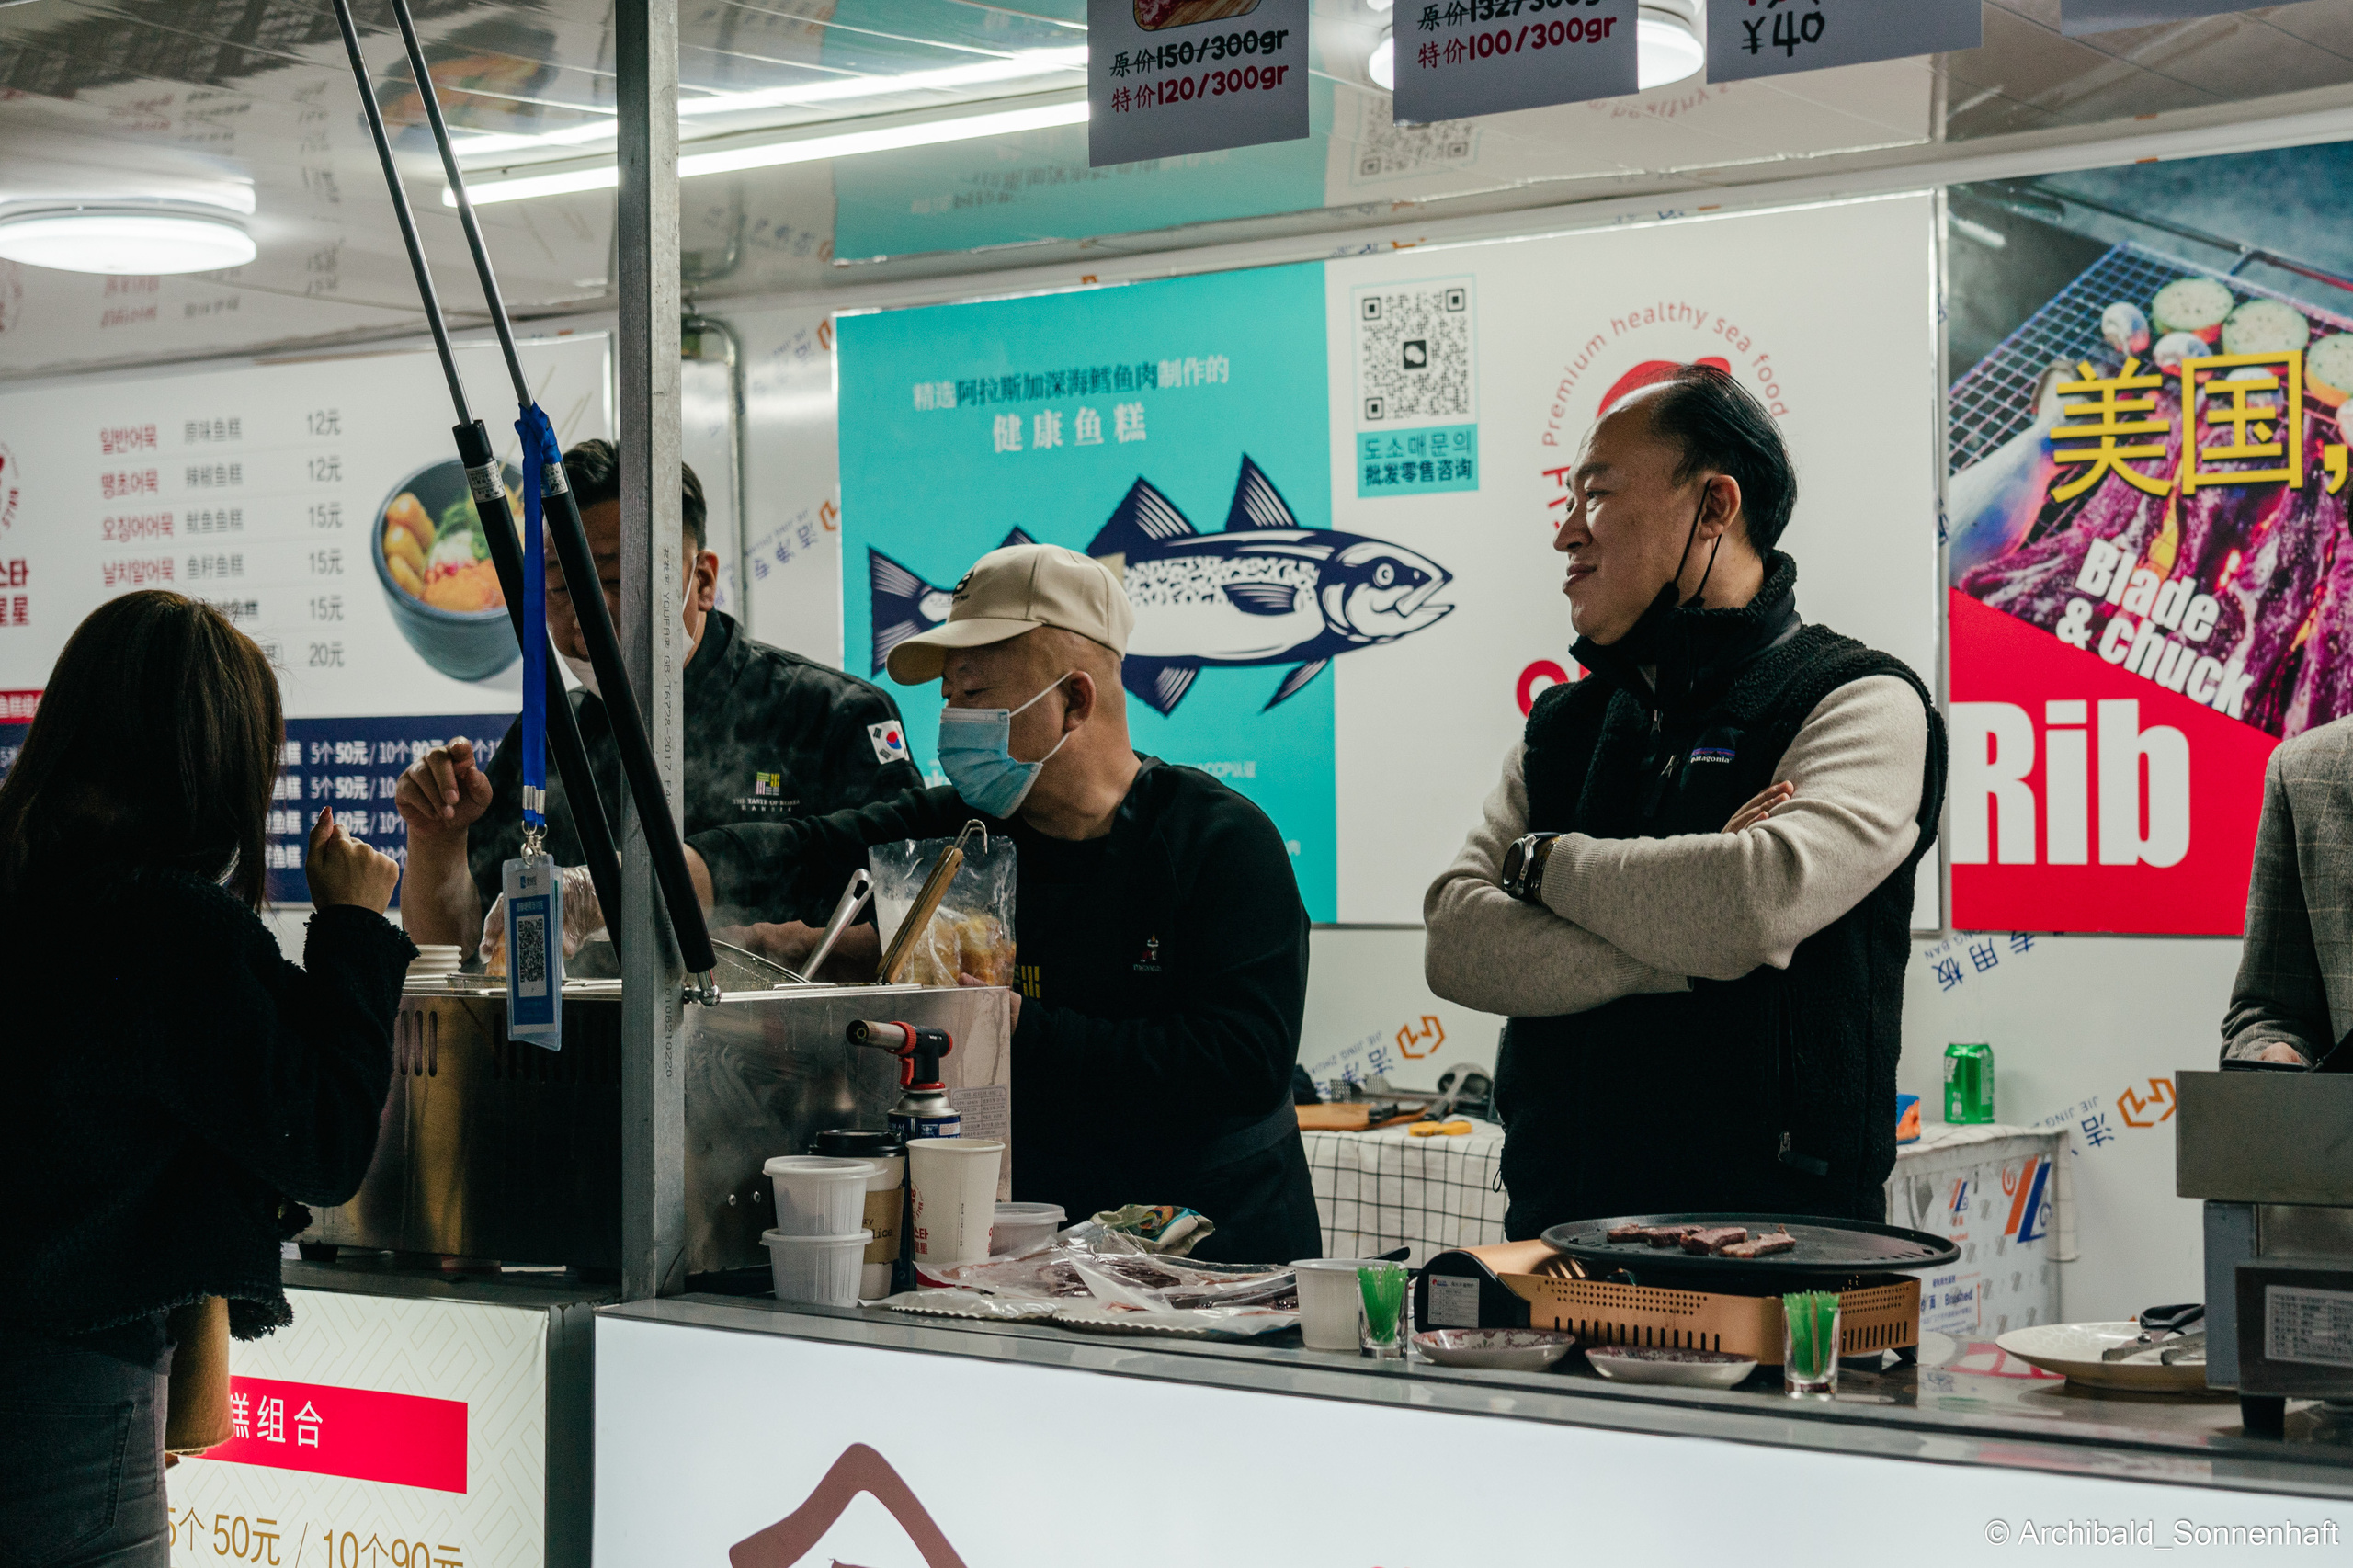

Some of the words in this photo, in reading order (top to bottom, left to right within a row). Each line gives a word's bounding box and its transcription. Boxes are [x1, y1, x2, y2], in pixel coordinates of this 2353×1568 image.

[1417, 17, 1617, 69] 特价100/300gr
[1741, 11, 1824, 57] ¥40
[1109, 29, 1289, 78] 原价150/300gr
[1111, 65, 1289, 113] 特价120/300gr
[1542, 333, 1608, 447] Premium
[1609, 301, 1709, 336] healthy
[1712, 316, 1752, 353] sea
[1751, 353, 1790, 417] food
[100, 424, 157, 454] 일반어묵
[306, 408, 342, 436] 12元
[993, 401, 1146, 453] 健康鱼糕
[1364, 430, 1471, 460] 도소매문의
[307, 455, 343, 482] 12元
[308, 502, 343, 529] 15元
[309, 548, 344, 575] 15元
[309, 594, 344, 621] 15元
[2075, 537, 2219, 642] Blade
[2055, 597, 2093, 651] &
[309, 642, 345, 668] 20元
[1690, 755, 1730, 764] patagonia
[1949, 698, 2191, 869] Rib
